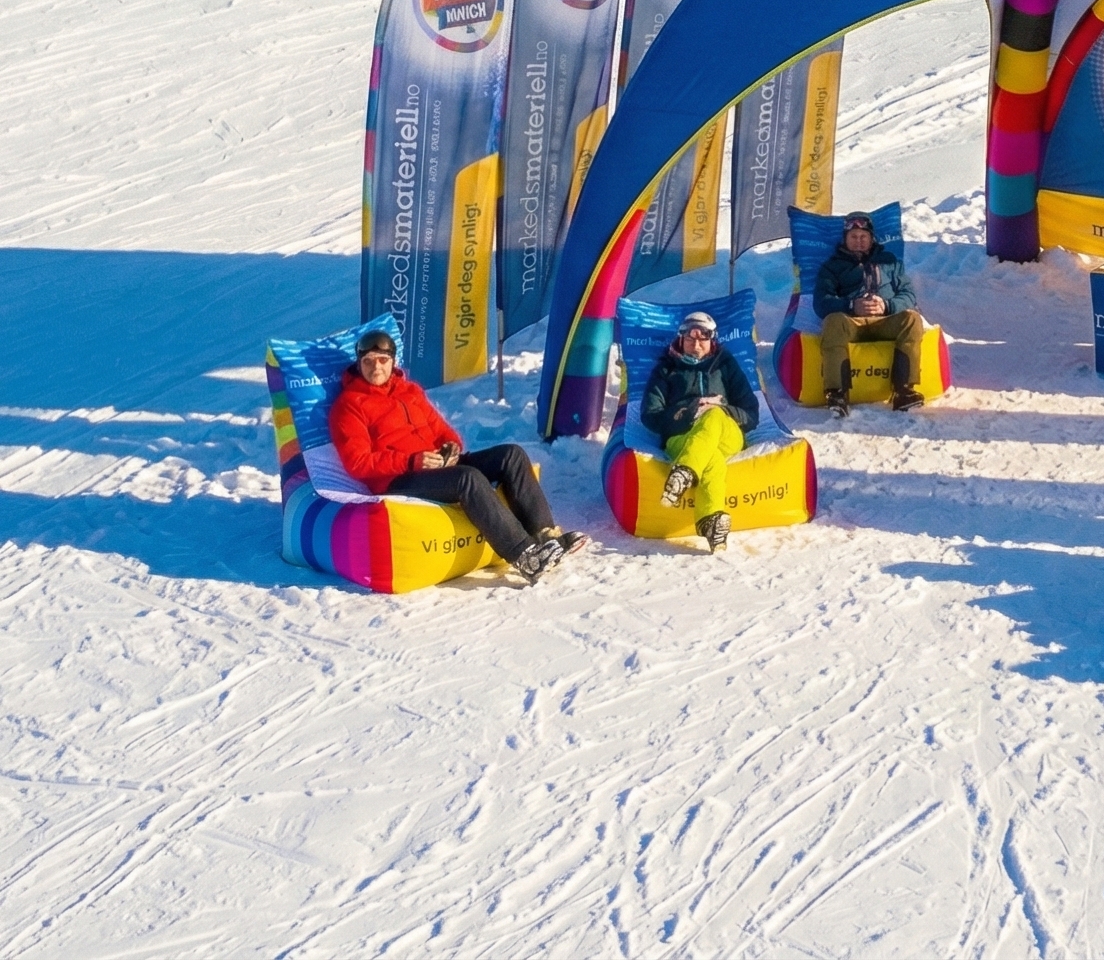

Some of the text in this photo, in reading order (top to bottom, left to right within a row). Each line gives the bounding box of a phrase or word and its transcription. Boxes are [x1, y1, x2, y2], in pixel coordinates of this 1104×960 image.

[461, 202, 482, 257] synlig!
[457, 259, 479, 294] deg
[455, 332, 470, 350] Vi
[742, 482, 789, 506] synlig!
[421, 538, 437, 553] Vi
